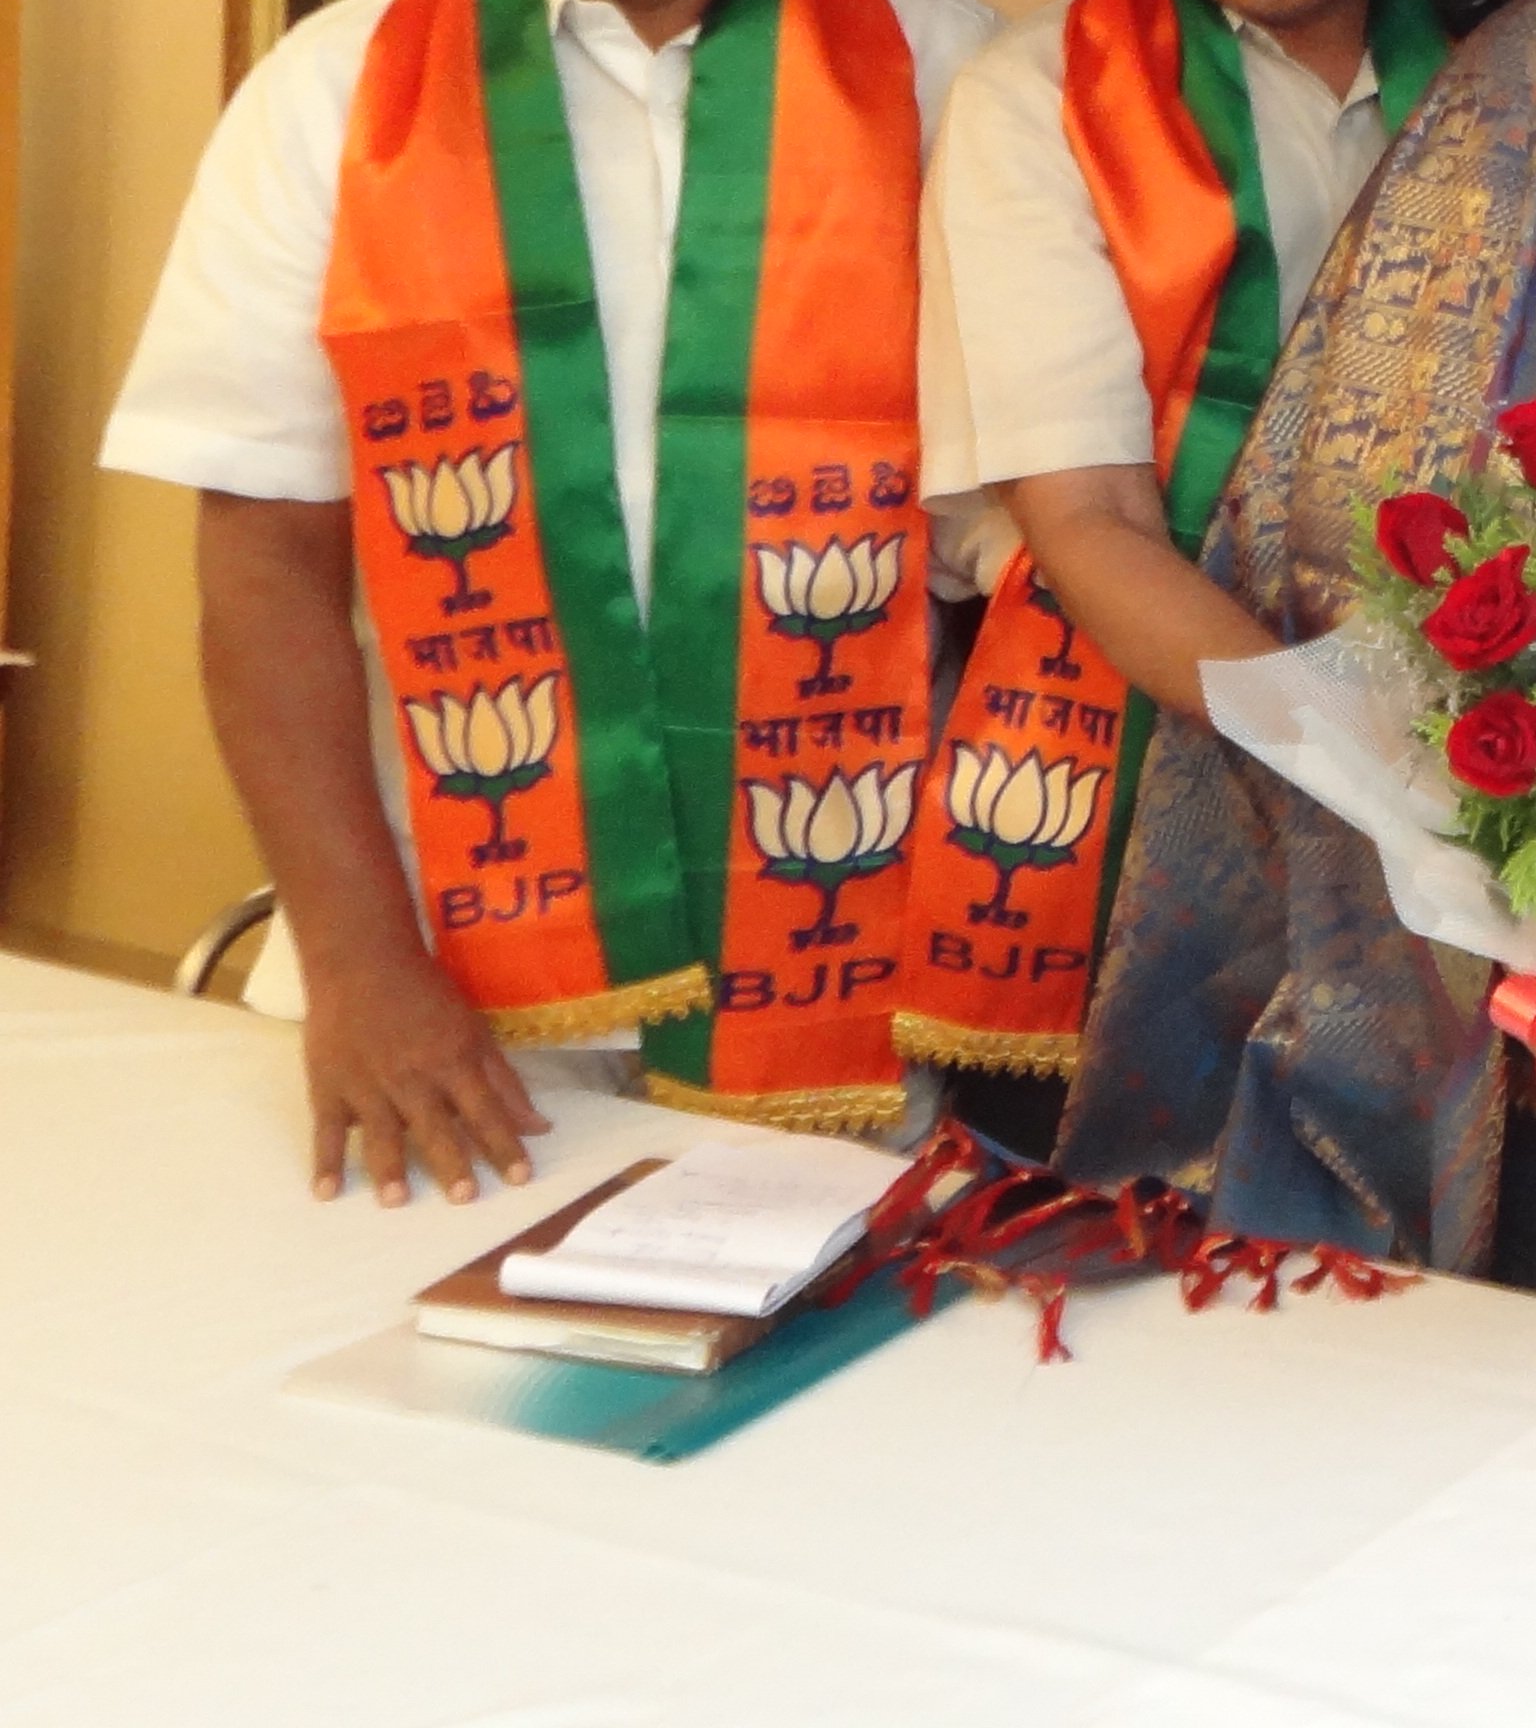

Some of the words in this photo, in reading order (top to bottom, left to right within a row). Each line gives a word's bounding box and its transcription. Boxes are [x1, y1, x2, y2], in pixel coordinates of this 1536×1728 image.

[440, 872, 583, 931] BJP
[930, 932, 1090, 981] BJP
[720, 958, 896, 1013] BJP
